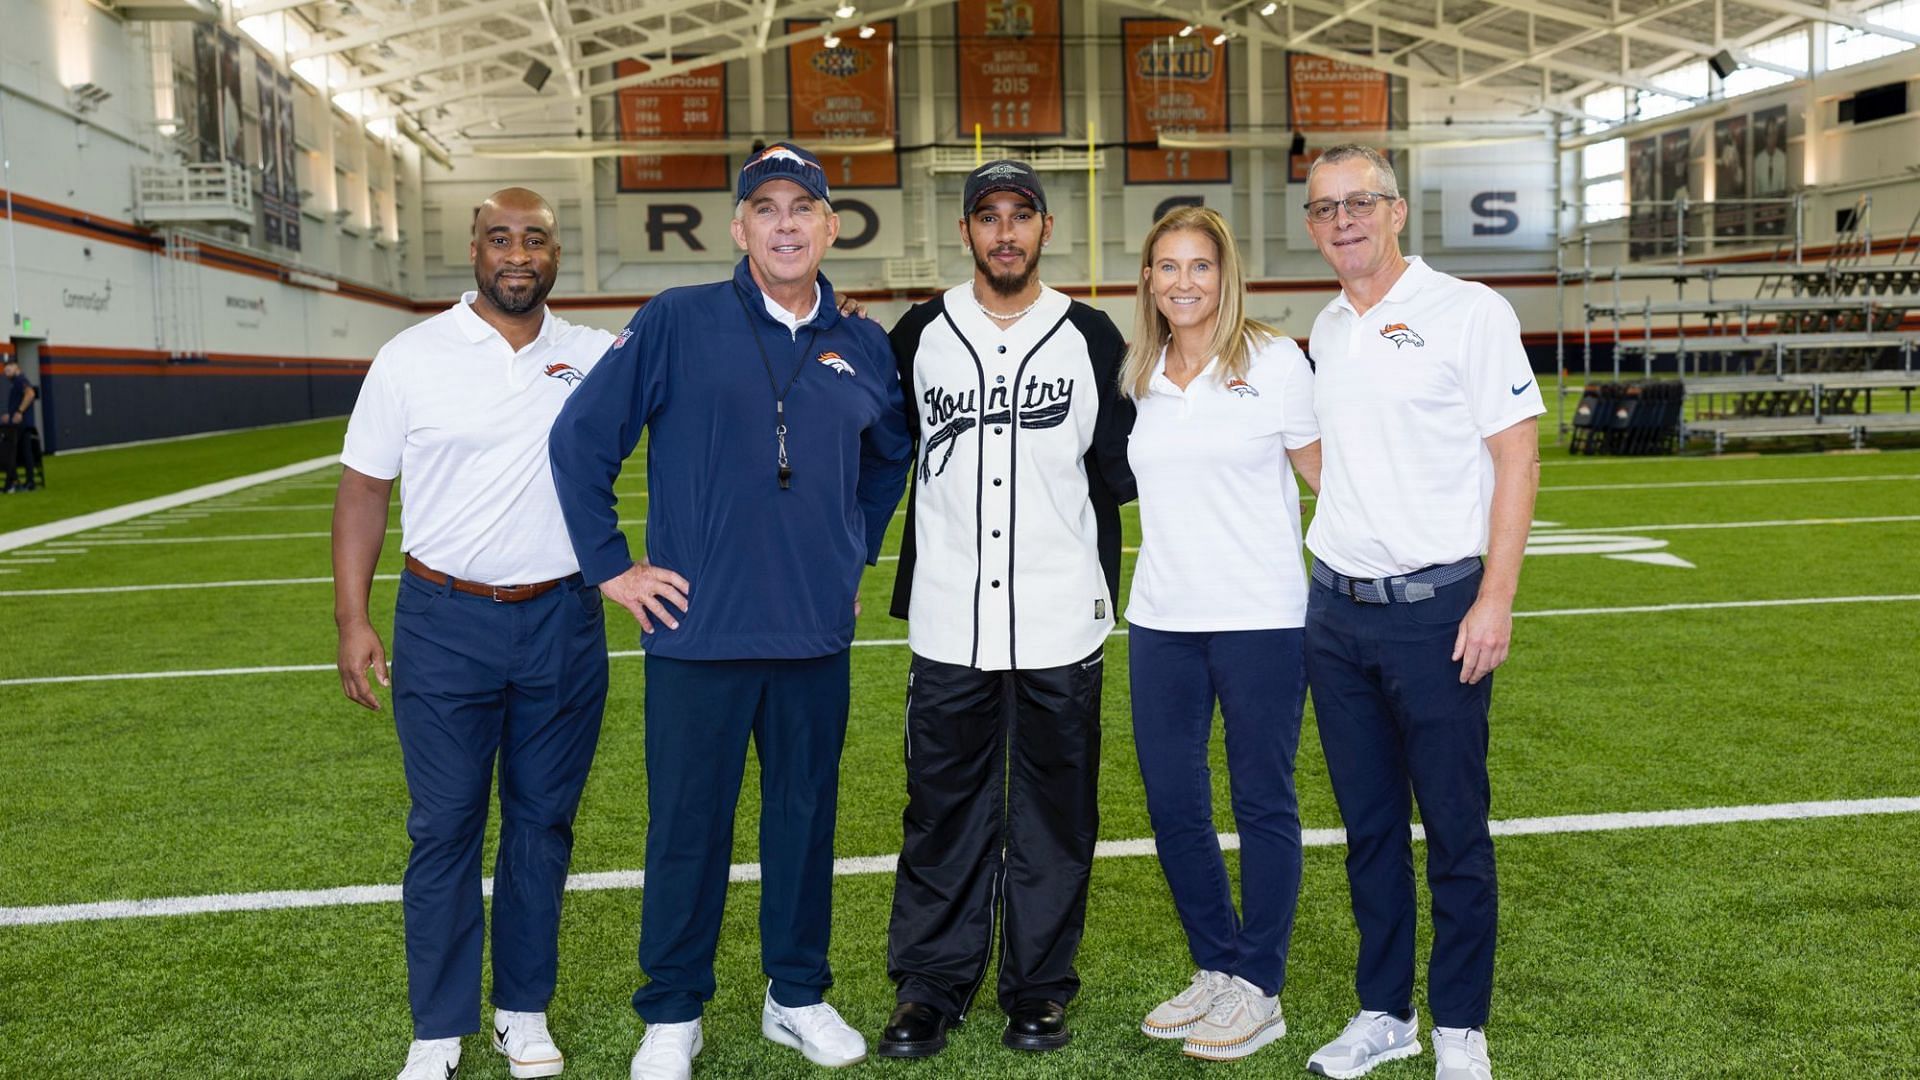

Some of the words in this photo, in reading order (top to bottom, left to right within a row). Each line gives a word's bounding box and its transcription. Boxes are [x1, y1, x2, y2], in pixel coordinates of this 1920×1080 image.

[1295, 61, 1329, 72] AFC
[1295, 72, 1384, 81] CHAMPIONS
[992, 78, 1029, 94] 2015
[646, 204, 706, 251] R
[1470, 191, 1520, 236] S
[923, 375, 1075, 427] Kountry
